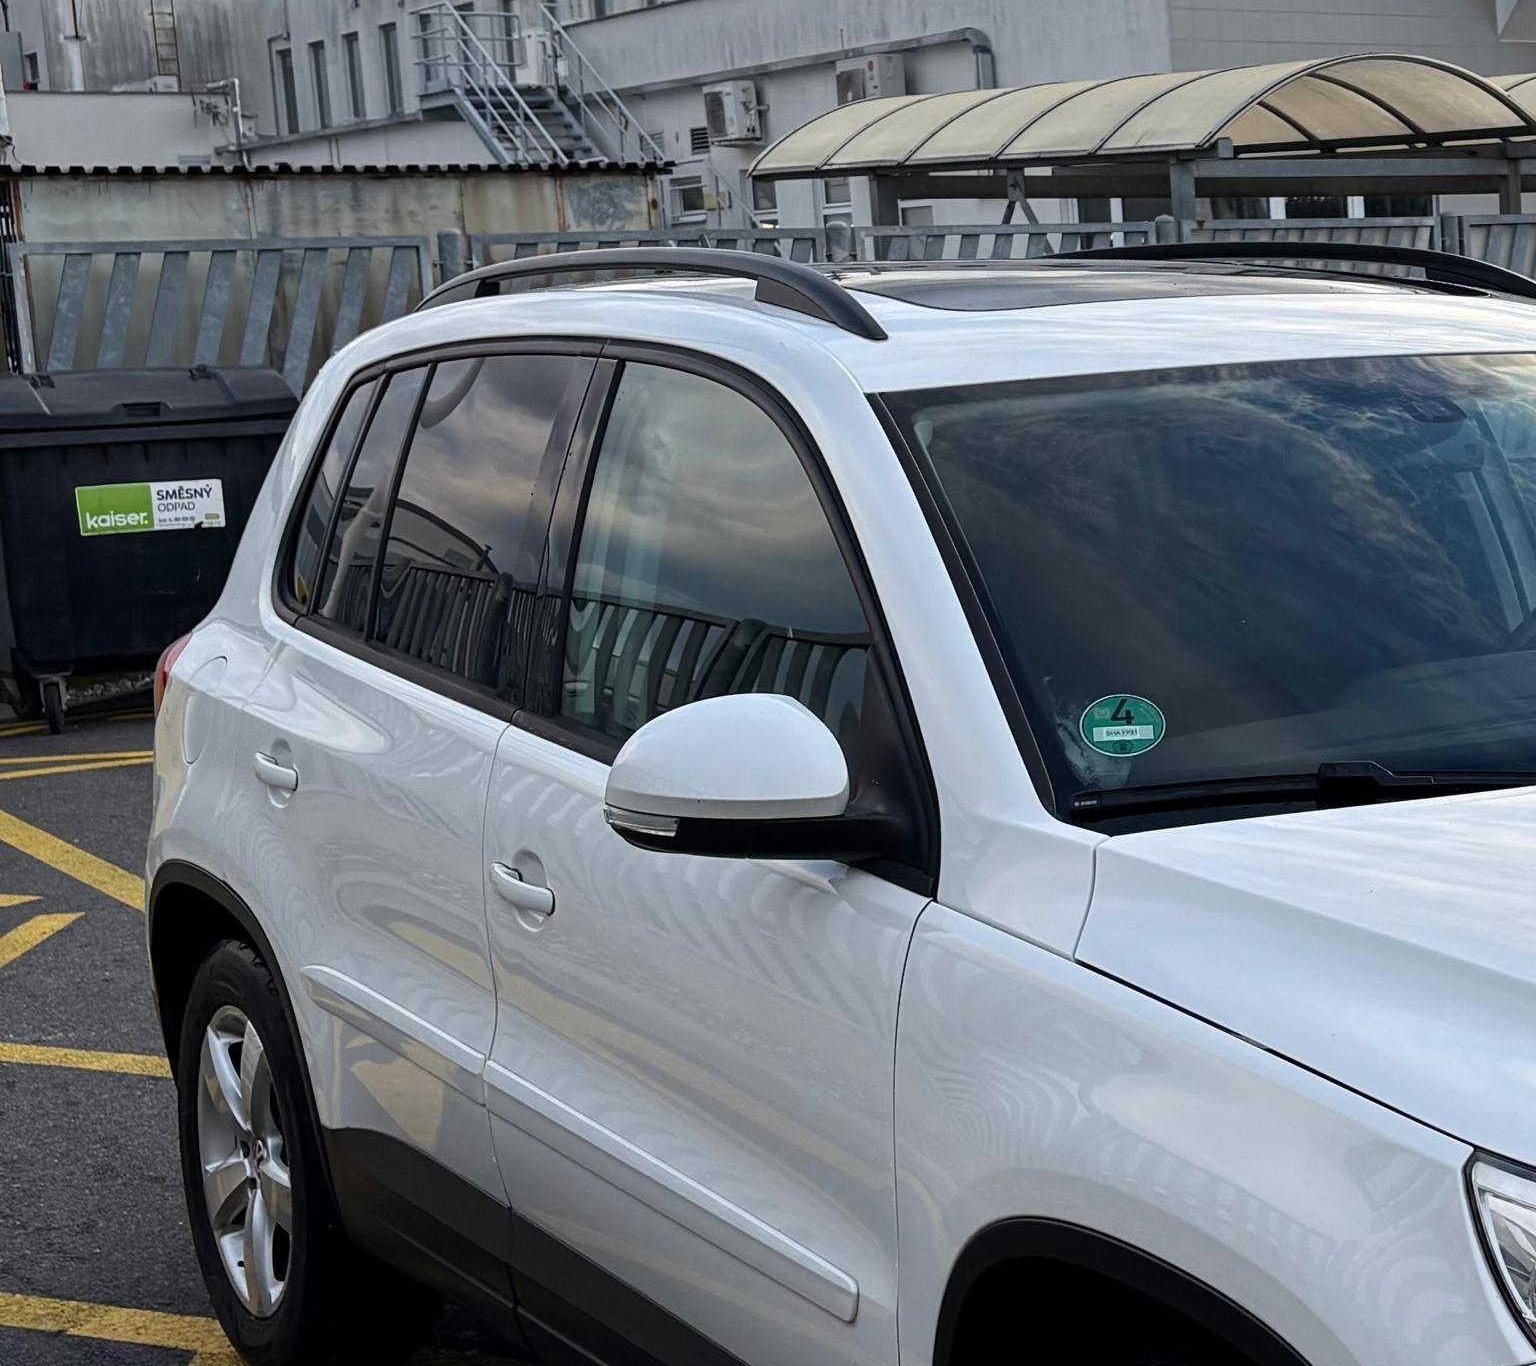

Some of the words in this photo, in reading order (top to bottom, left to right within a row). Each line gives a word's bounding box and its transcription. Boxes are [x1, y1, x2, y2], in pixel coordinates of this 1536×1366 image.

[156, 484, 212, 501] SMĚSNÝ
[157, 501, 196, 513] ODPAD
[1110, 698, 1135, 725] 4
